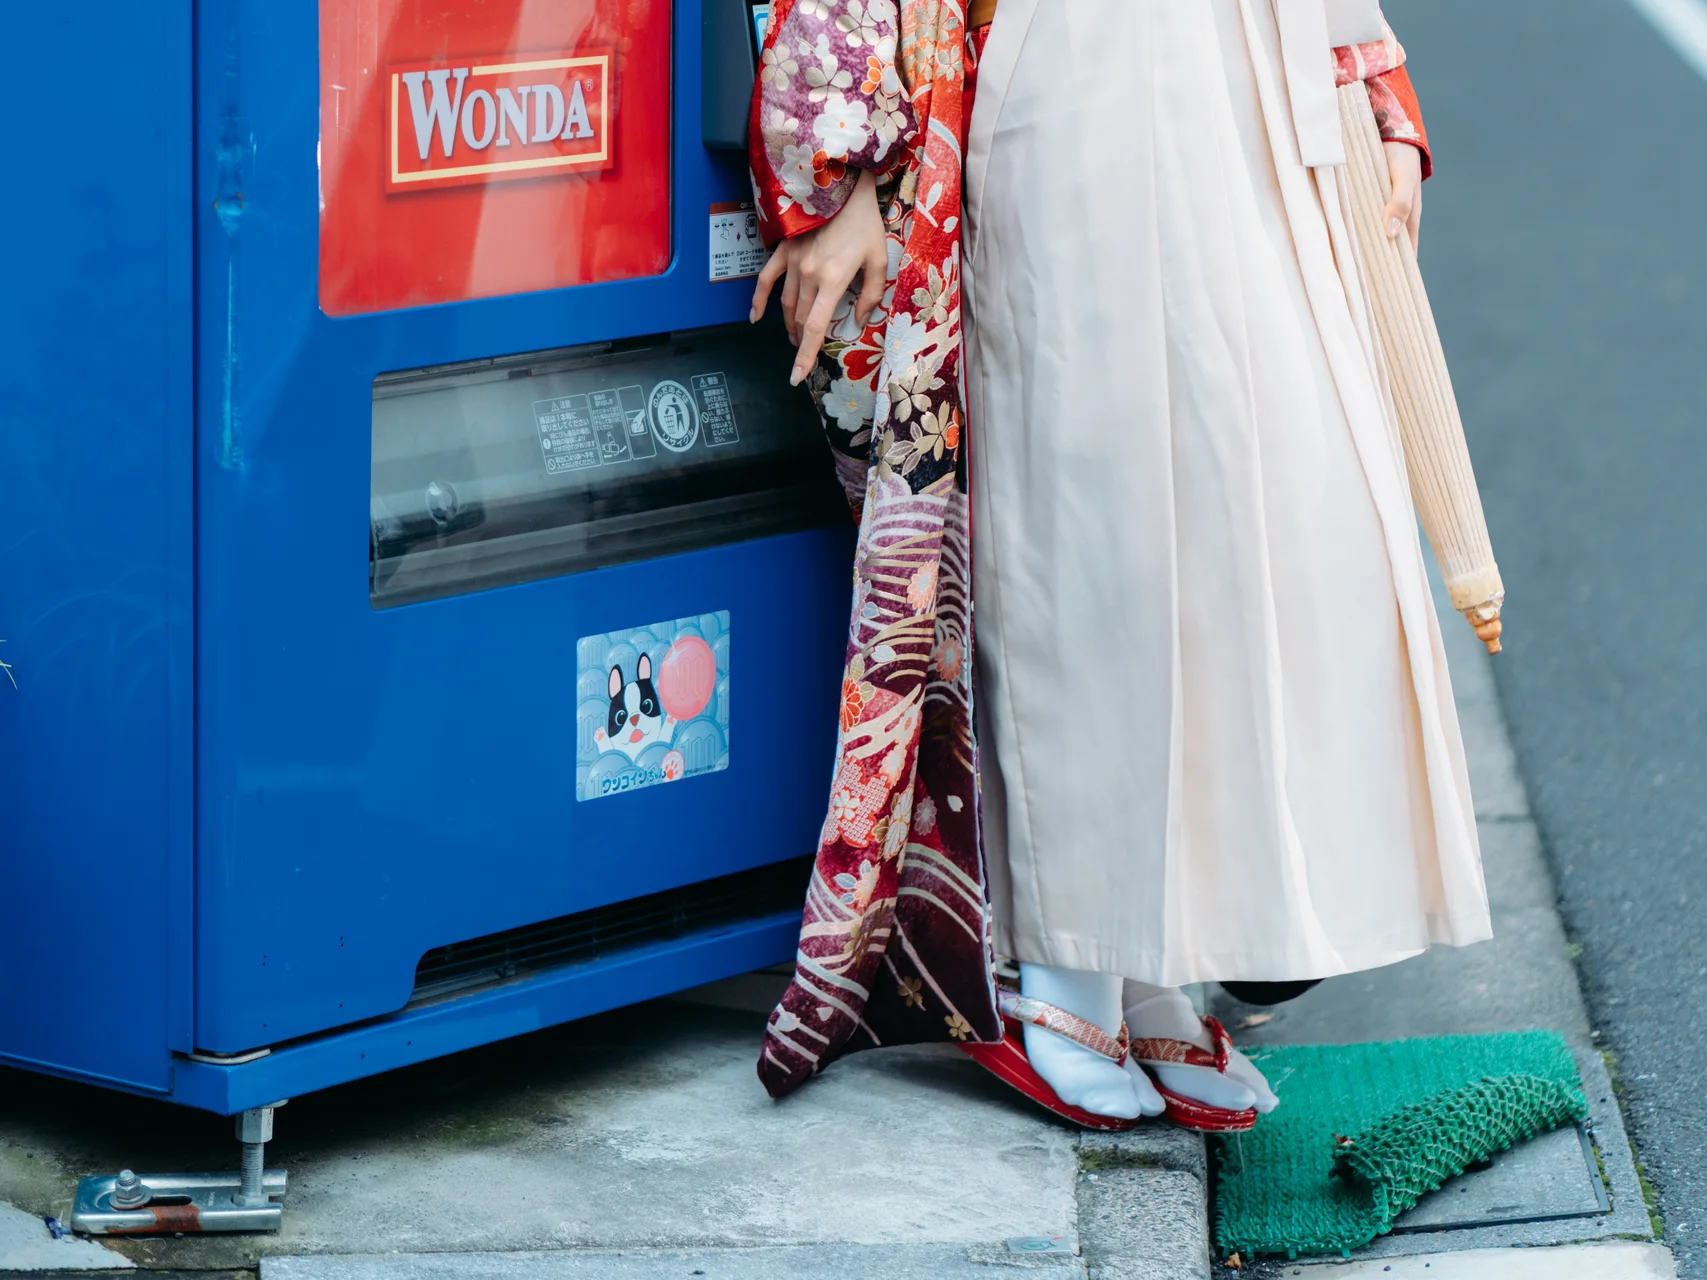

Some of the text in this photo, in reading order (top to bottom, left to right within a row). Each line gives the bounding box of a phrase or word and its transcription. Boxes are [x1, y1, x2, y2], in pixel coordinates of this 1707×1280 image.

[403, 67, 595, 160] WONDA
[652, 384, 690, 409] のんだあとは
[661, 427, 695, 447] リサイクル
[601, 766, 667, 794] ワンコインちゃん
